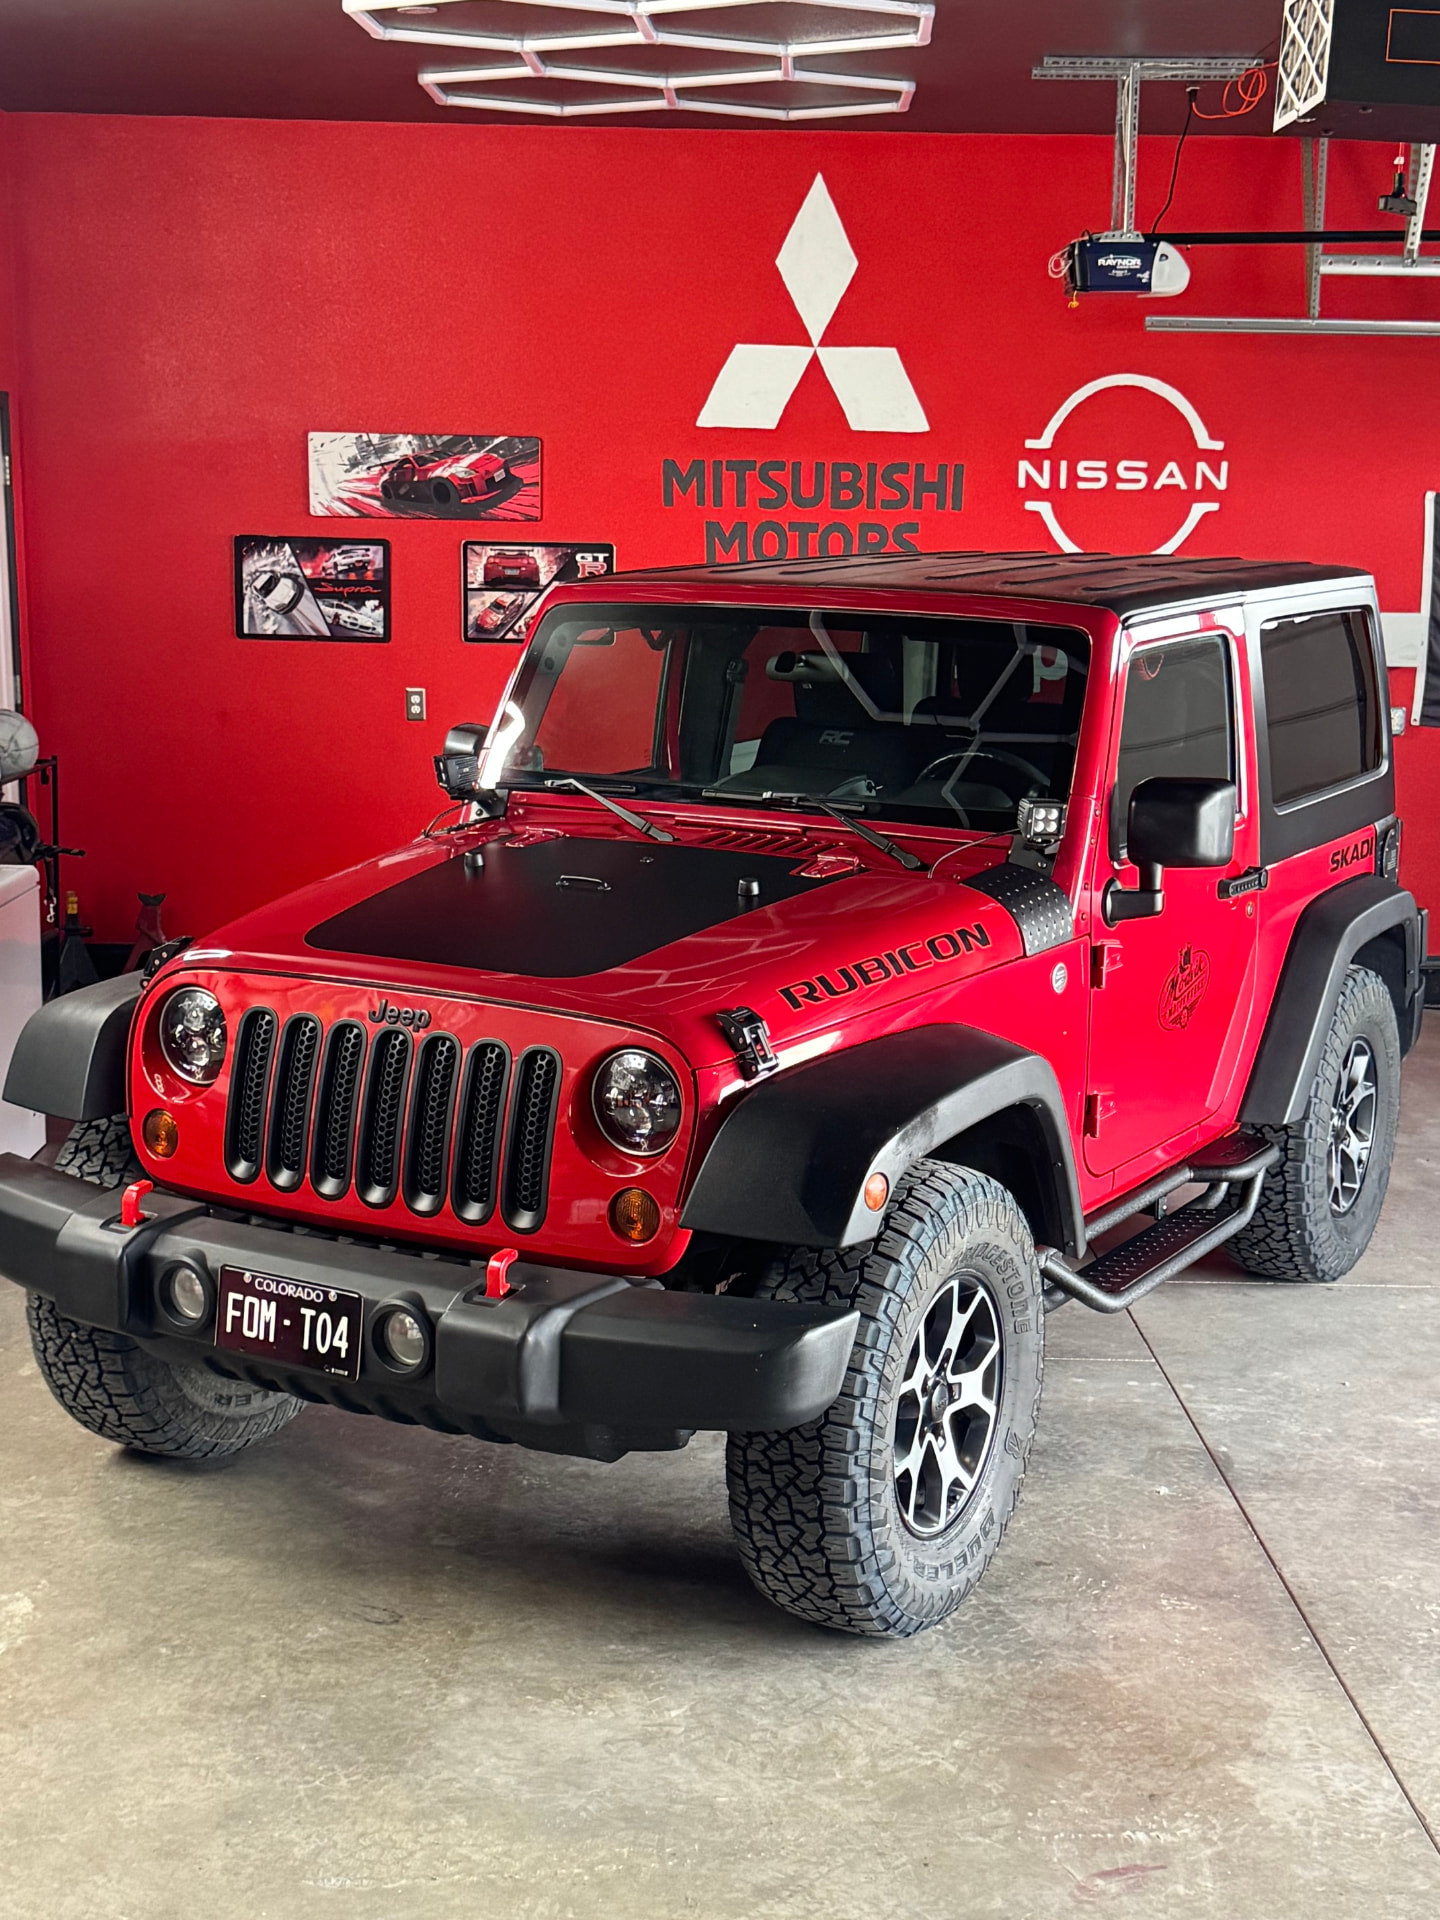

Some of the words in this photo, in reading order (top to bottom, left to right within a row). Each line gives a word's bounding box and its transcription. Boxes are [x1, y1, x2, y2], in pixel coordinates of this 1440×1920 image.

[1098, 258, 1141, 267] RAYNOR
[662, 458, 964, 511] MITSUBISHI
[1018, 460, 1228, 490] NISSAN
[576, 553, 609, 562] GT
[705, 520, 920, 565] MOTORS
[314, 582, 382, 597] Supra
[1329, 837, 1373, 873] SKADI
[778, 923, 991, 1011] RUBICON
[369, 999, 431, 1032] Jeep
[255, 1278, 324, 1303] COLORADO
[956, 1242, 1031, 1334] DGESTONE
